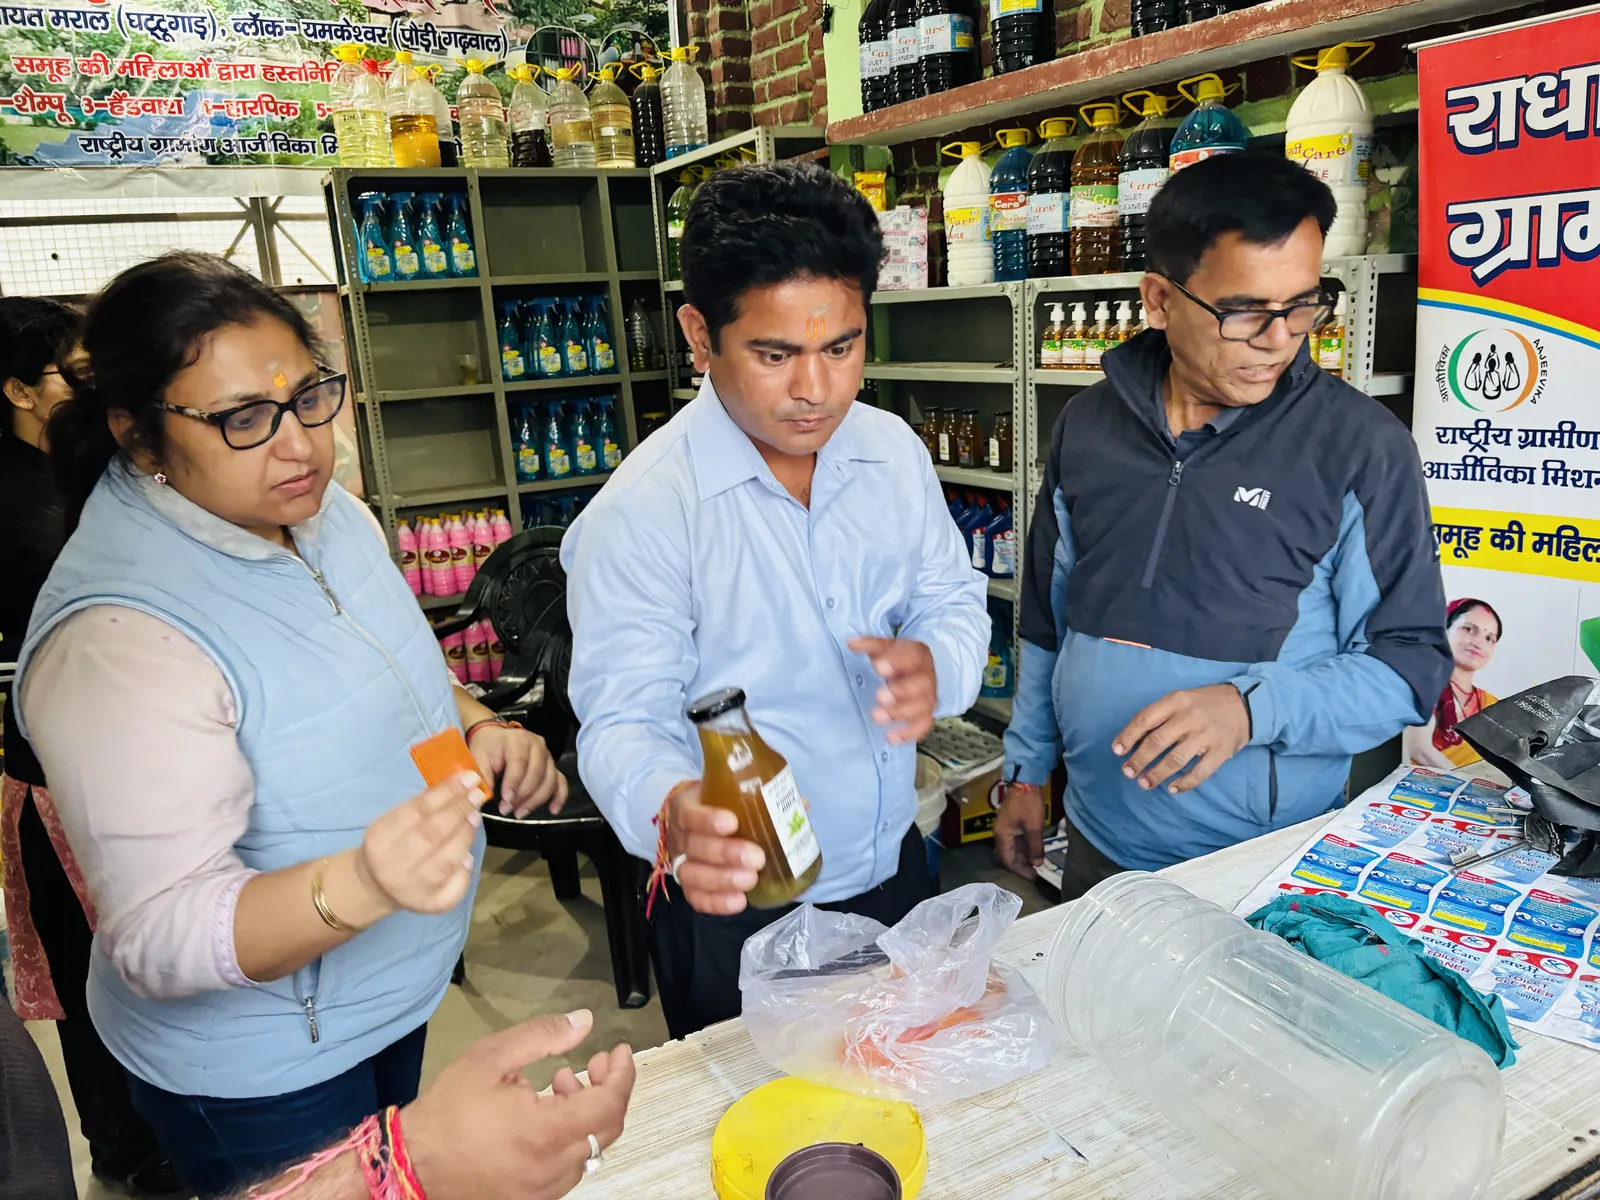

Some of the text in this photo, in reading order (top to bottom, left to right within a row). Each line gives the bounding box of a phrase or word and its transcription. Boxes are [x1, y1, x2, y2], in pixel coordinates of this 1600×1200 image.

[0, 6, 44, 26] ायत
[49, 9, 110, 31] मराल
[302, 18, 388, 45] यमकेश्वर
[898, 36, 916, 45] Car
[871, 48, 888, 58] Car
[12, 57, 71, 82] समूह
[76, 52, 109, 75] की
[116, 54, 213, 78] महिलाओं
[217, 62, 256, 82] द्वारा
[79, 132, 143, 159] राष्ट्रीय
[222, 133, 316, 155] आजीविका
[1302, 147, 1346, 160] Care
[1093, 193, 1118, 205] Car
[1530, 338, 1548, 404] AAJEEVIKA
[1435, 418, 1600, 453] राष्ट्रीय ग्रामीण
[1423, 455, 1537, 485] आजीविका
[1490, 520, 1526, 552] की
[1502, 855, 1544, 869] LEANER
[1511, 853, 1540, 864] OILET
[1426, 949, 1467, 965] TOILET
[1495, 976, 1554, 998] CLEANER
[1508, 975, 1550, 989] TOILET
[1515, 991, 1545, 1004] 500ML
